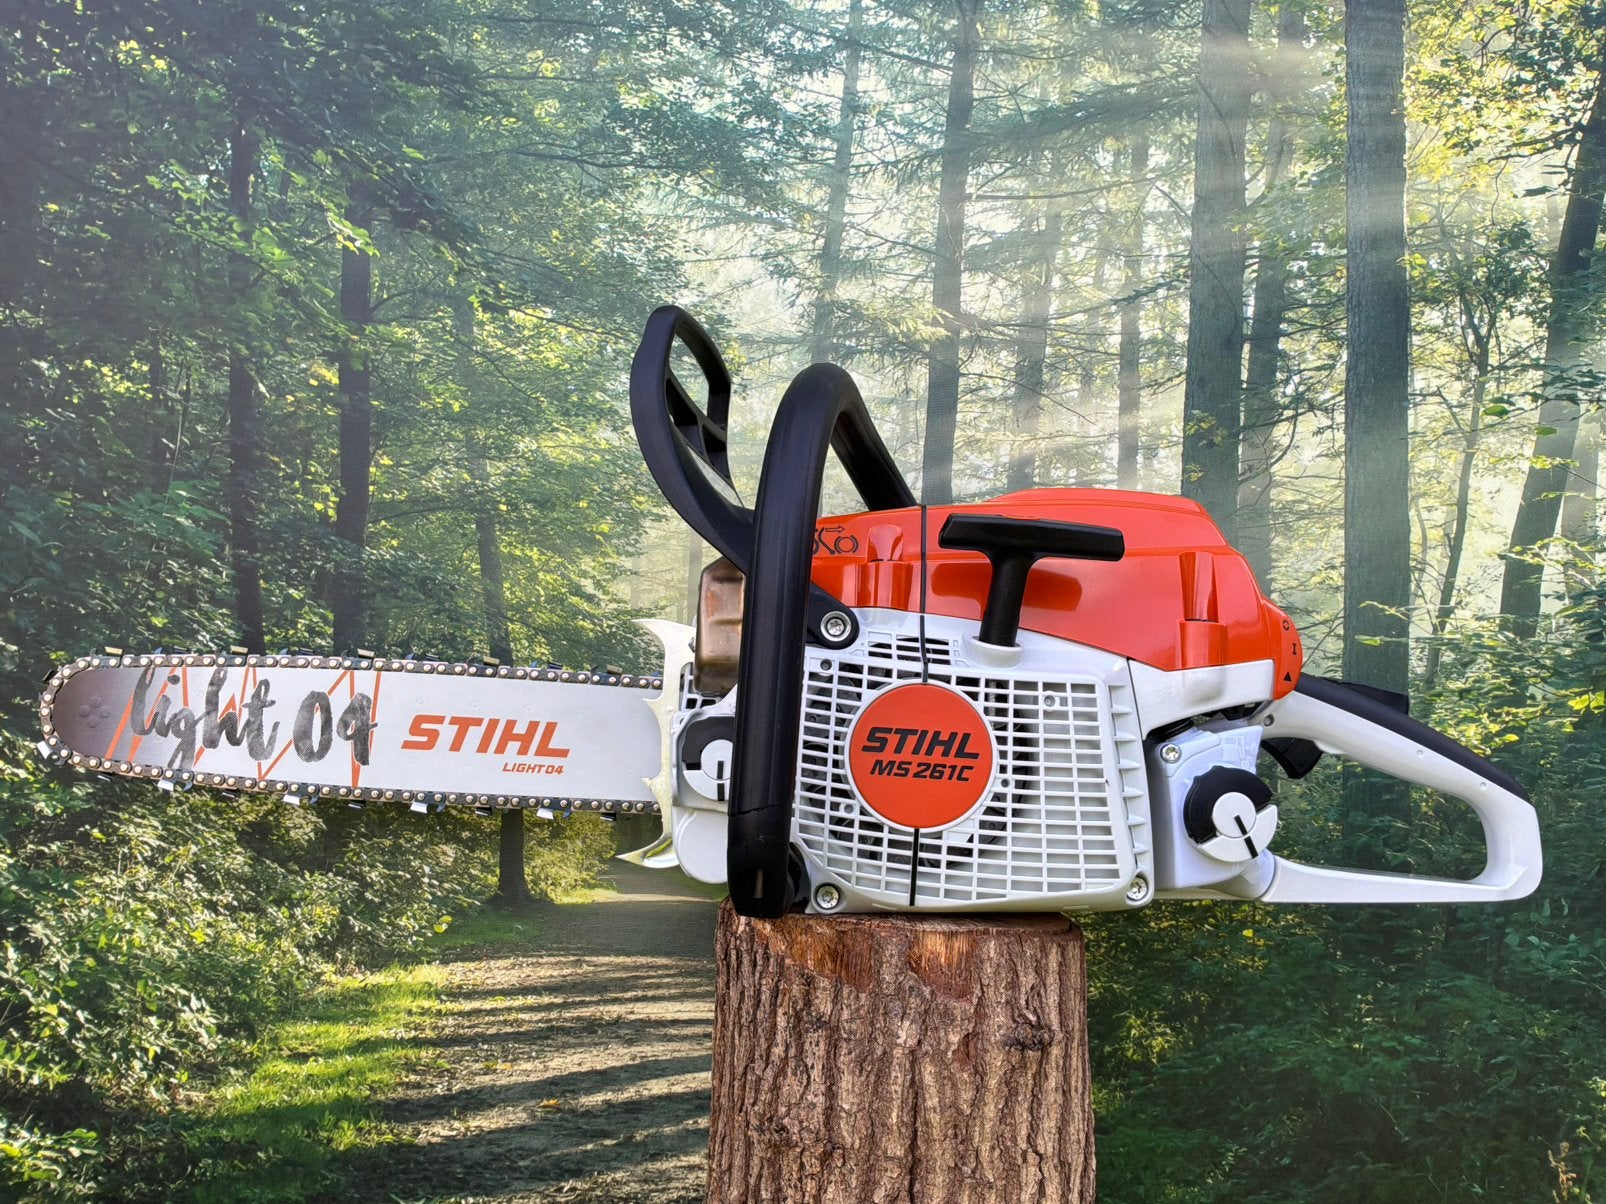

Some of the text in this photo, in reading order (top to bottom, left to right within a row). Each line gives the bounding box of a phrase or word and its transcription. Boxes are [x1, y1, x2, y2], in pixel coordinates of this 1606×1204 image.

[401, 714, 571, 758] STIHL
[861, 726, 980, 760] STIHL
[869, 759, 975, 782] MS 261C
